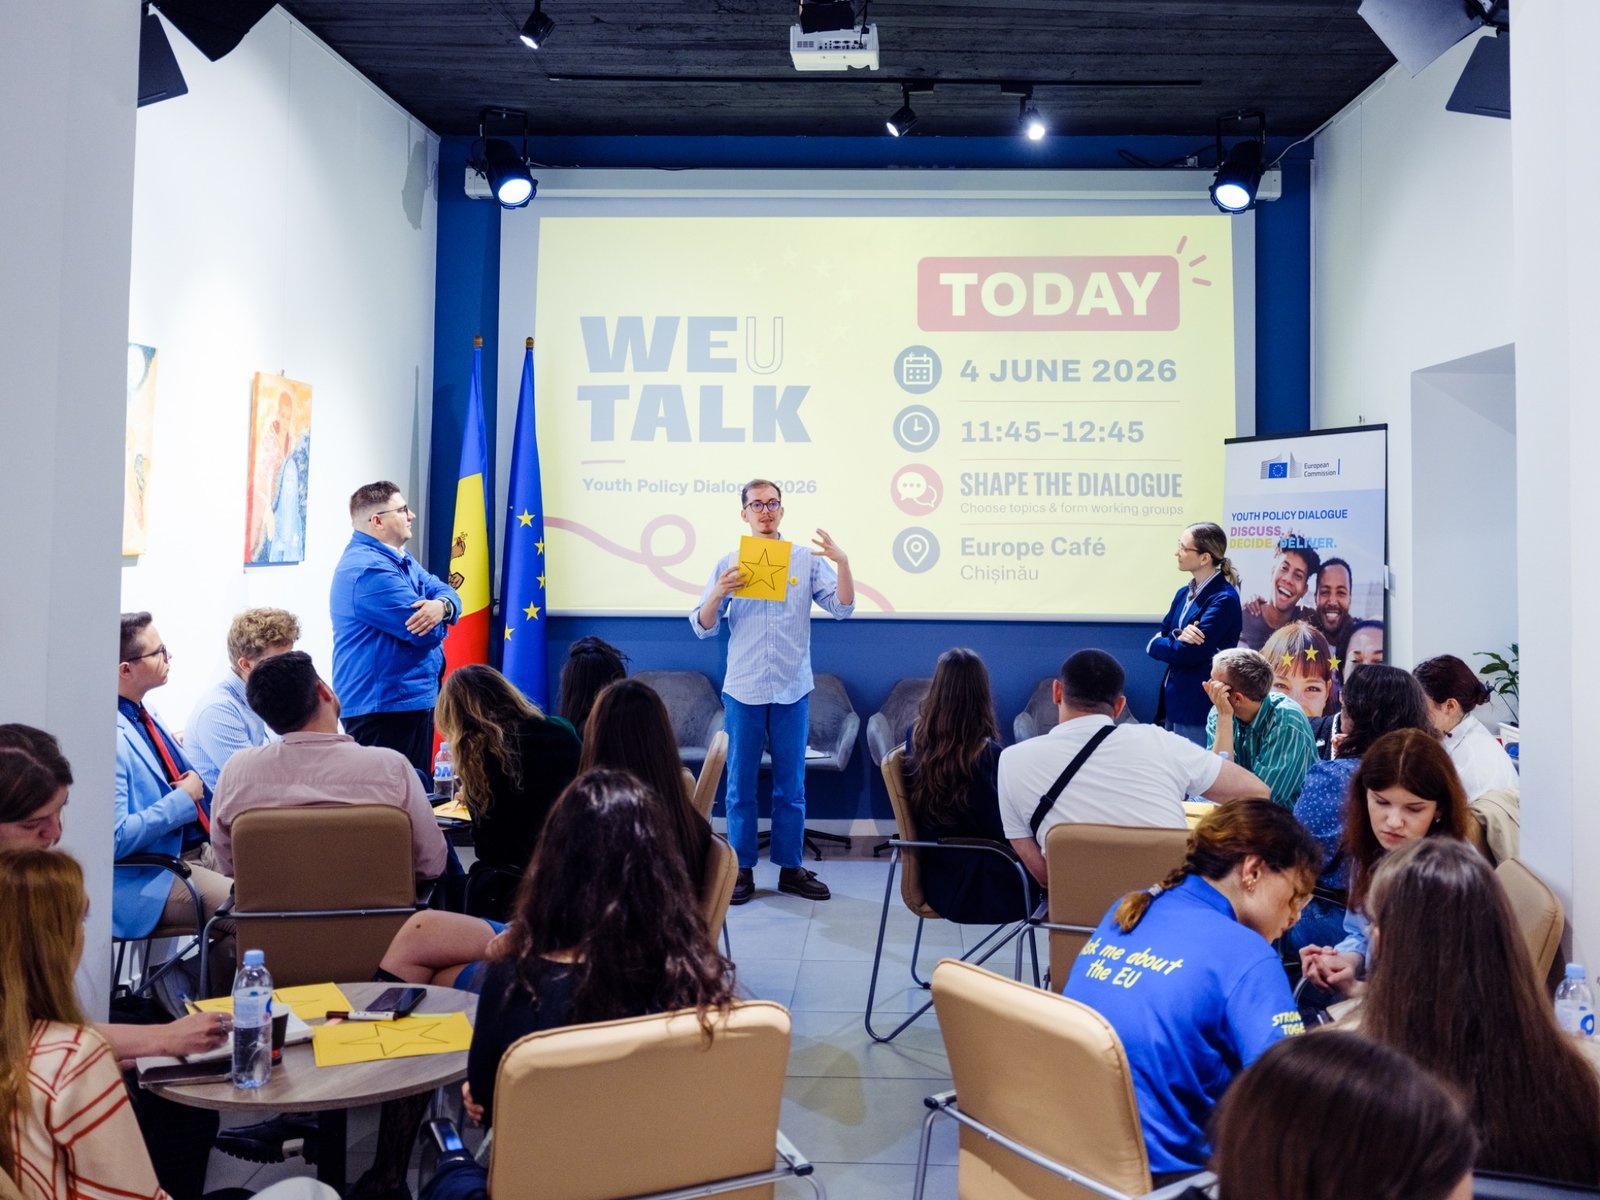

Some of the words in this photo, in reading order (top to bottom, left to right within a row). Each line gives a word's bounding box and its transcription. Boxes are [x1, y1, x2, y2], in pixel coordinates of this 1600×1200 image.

[939, 271, 1162, 317] TODAY
[959, 359, 980, 382] 4
[989, 359, 1081, 382] JUNE
[1092, 358, 1177, 382] 2026
[577, 384, 812, 443] TALK
[1303, 470, 1337, 478] Commission
[1304, 462, 1330, 470] European
[582, 477, 633, 493] Youth
[637, 478, 688, 496] Policy
[960, 472, 1029, 497] SHAPE
[1033, 472, 1073, 497] THE
[1078, 472, 1183, 498] DIALOGUE
[960, 502, 1007, 514] Choose
[1009, 502, 1047, 516] topics
[1049, 503, 1058, 514] &
[1060, 502, 1089, 514] form
[1091, 502, 1139, 516] working
[1142, 504, 1184, 516] groups
[1231, 511, 1261, 521] YOUTH
[1262, 510, 1297, 521] POLICY
[1298, 509, 1348, 520] DIALOGUE
[1230, 526, 1285, 537] DISCUSS.
[961, 537, 1045, 560] Europe
[1051, 536, 1106, 556] Café
[1229, 538, 1275, 549] DECIDE.
[1280, 537, 1338, 549] DELIVER.
[960, 564, 1039, 584] Chișinău
[1099, 944, 1126, 961] me
[1126, 948, 1183, 975] about
[1086, 959, 1112, 980] the
[1112, 966, 1143, 989] EU
